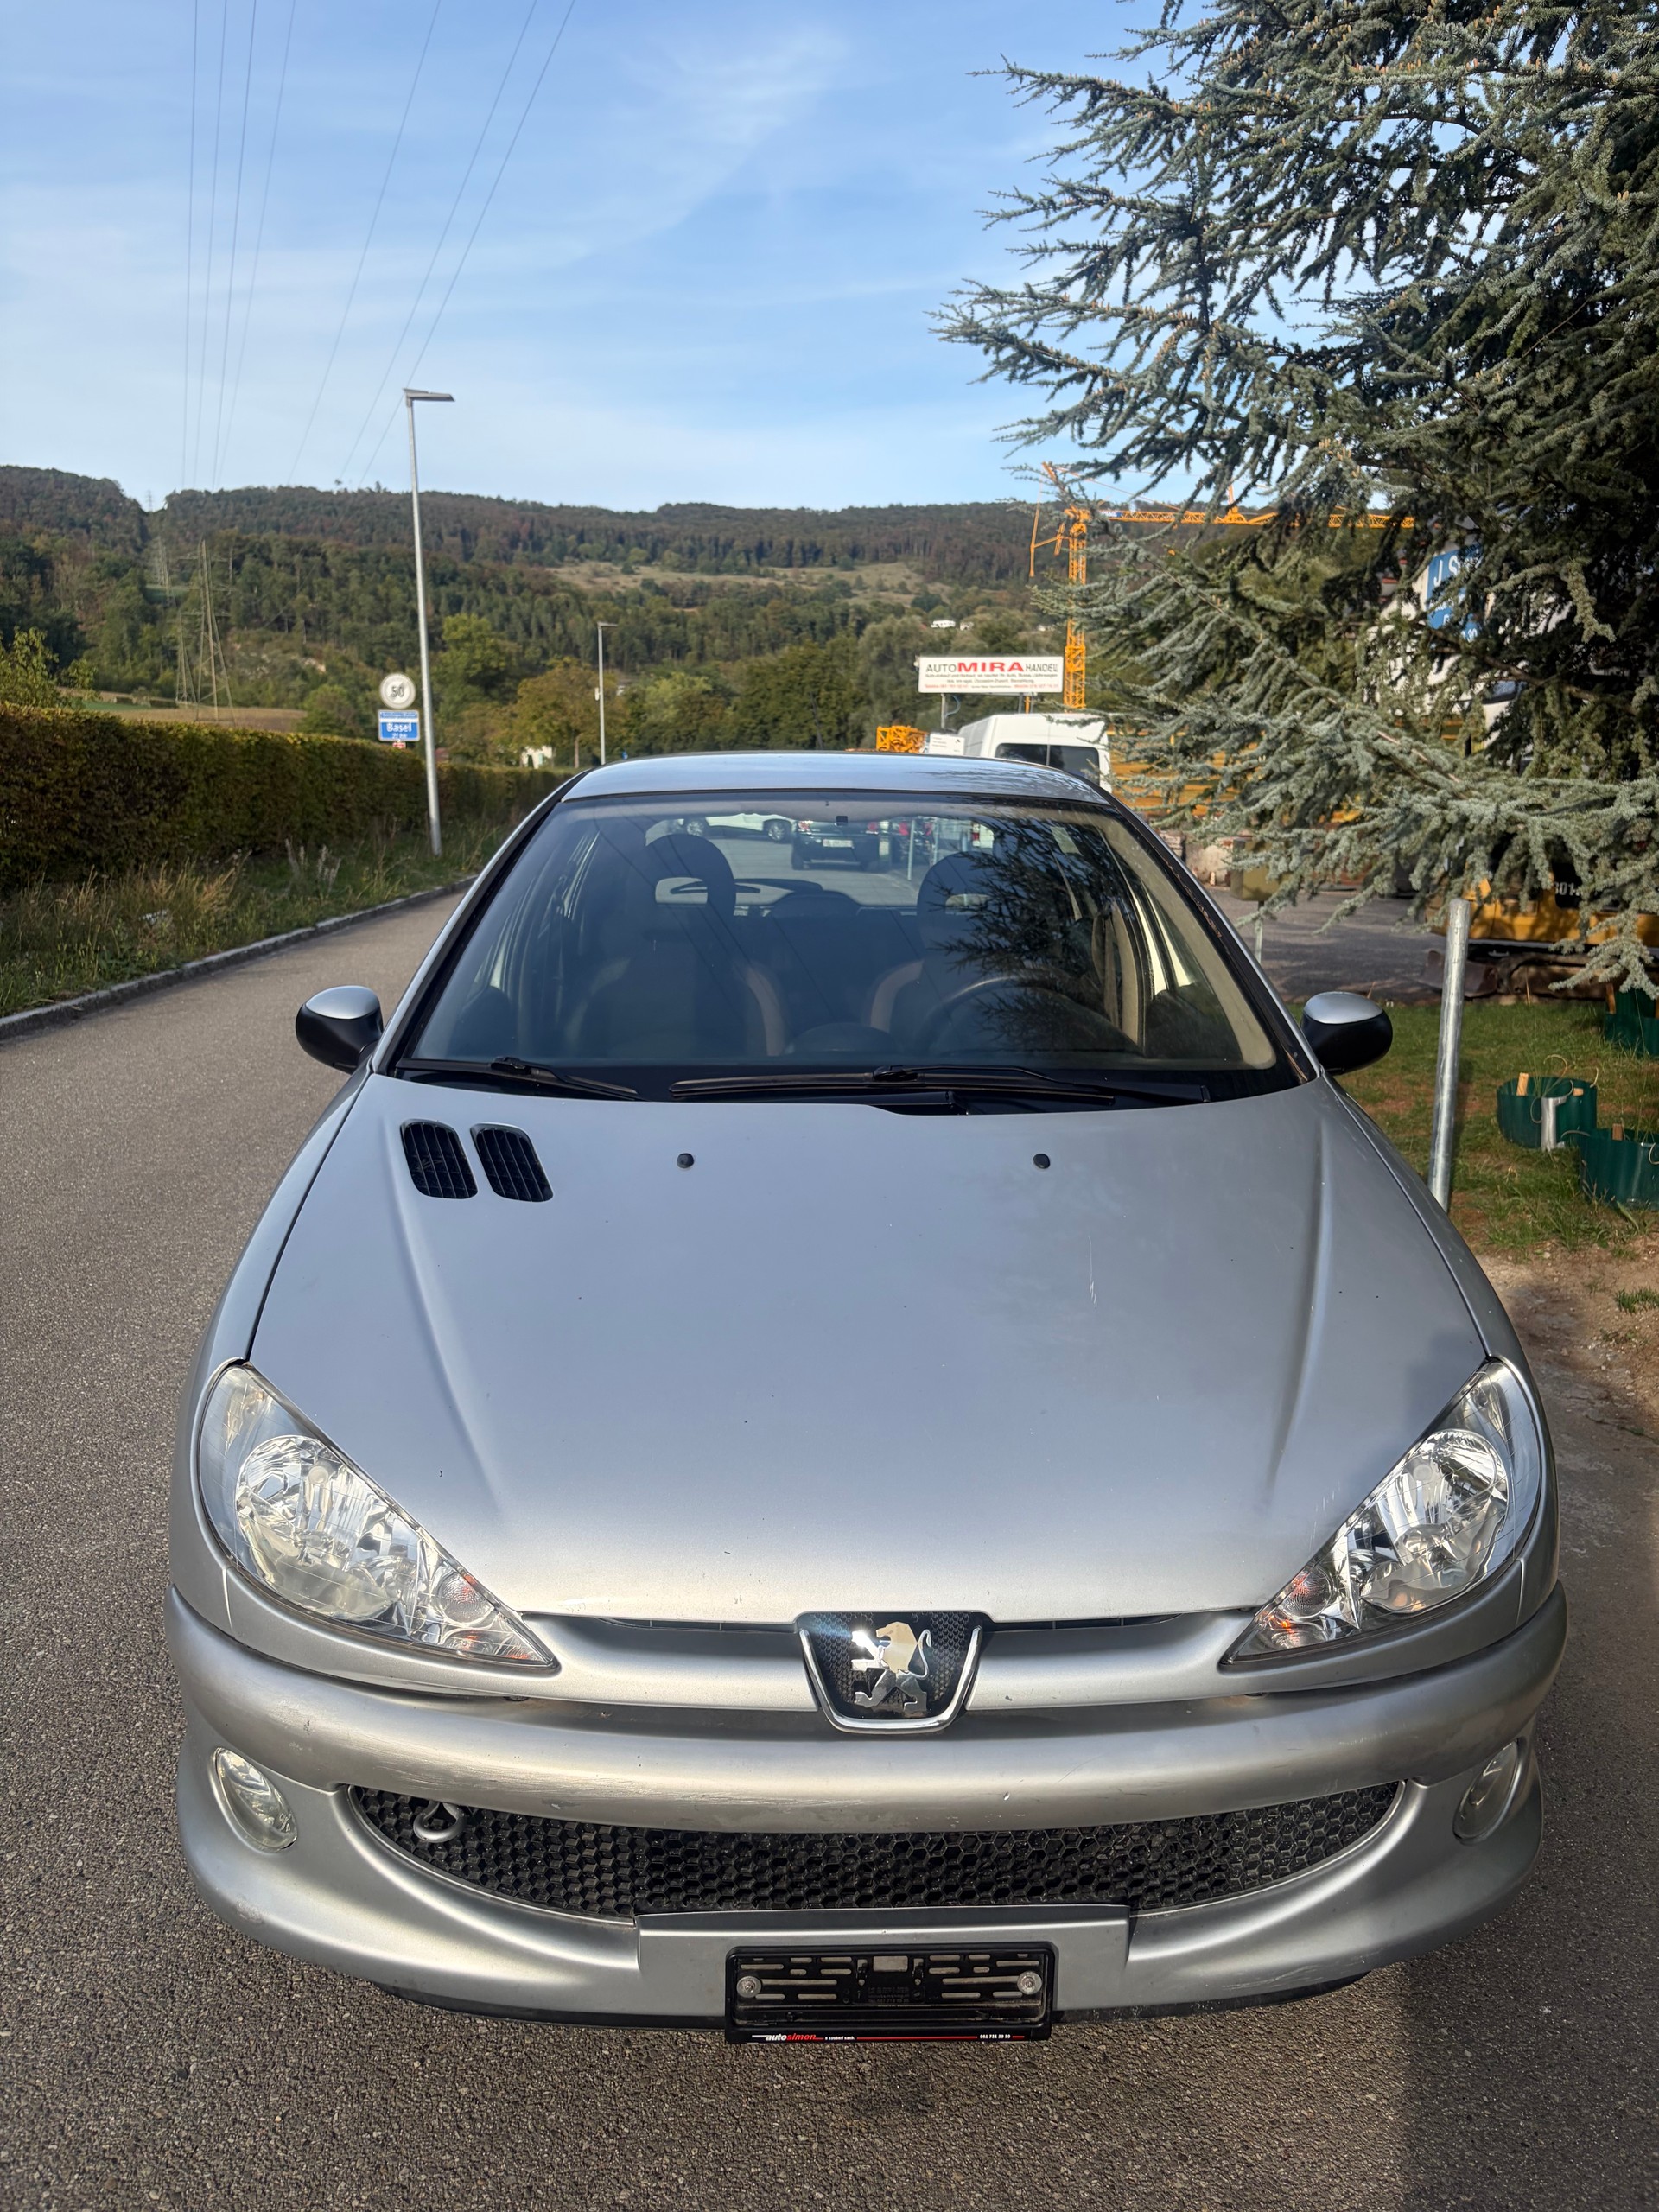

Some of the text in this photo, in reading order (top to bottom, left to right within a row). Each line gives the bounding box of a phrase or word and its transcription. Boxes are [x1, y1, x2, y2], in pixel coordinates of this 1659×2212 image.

[957, 662, 1024, 672] MIRA
[391, 685, 404, 698] 50
[386, 722, 412, 733] Basel
